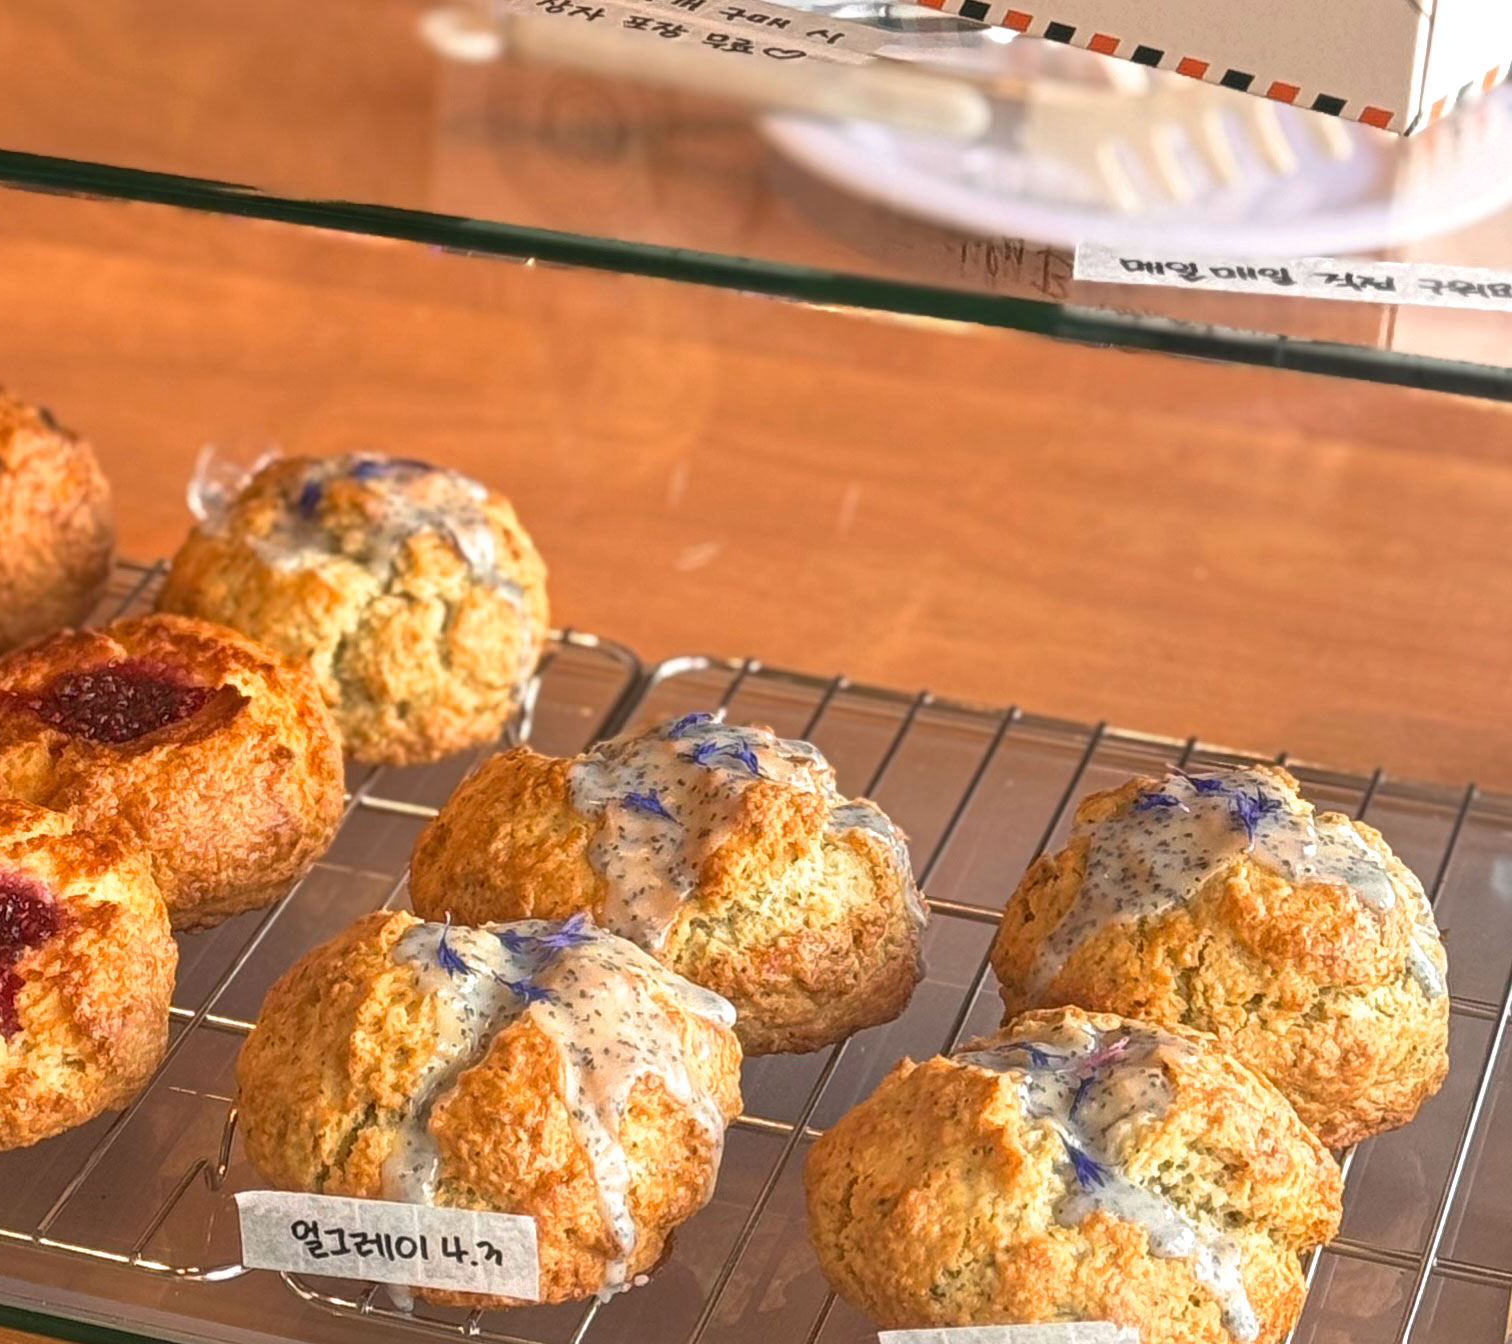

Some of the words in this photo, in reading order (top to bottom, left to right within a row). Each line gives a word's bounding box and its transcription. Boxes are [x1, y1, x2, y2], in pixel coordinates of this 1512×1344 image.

[622, 14, 690, 40] 포장
[718, 5, 792, 31] 구매
[805, 27, 847, 46] 시
[290, 1218, 429, 1262] 얼그레이
[440, 1235, 504, 1267] 4.3
